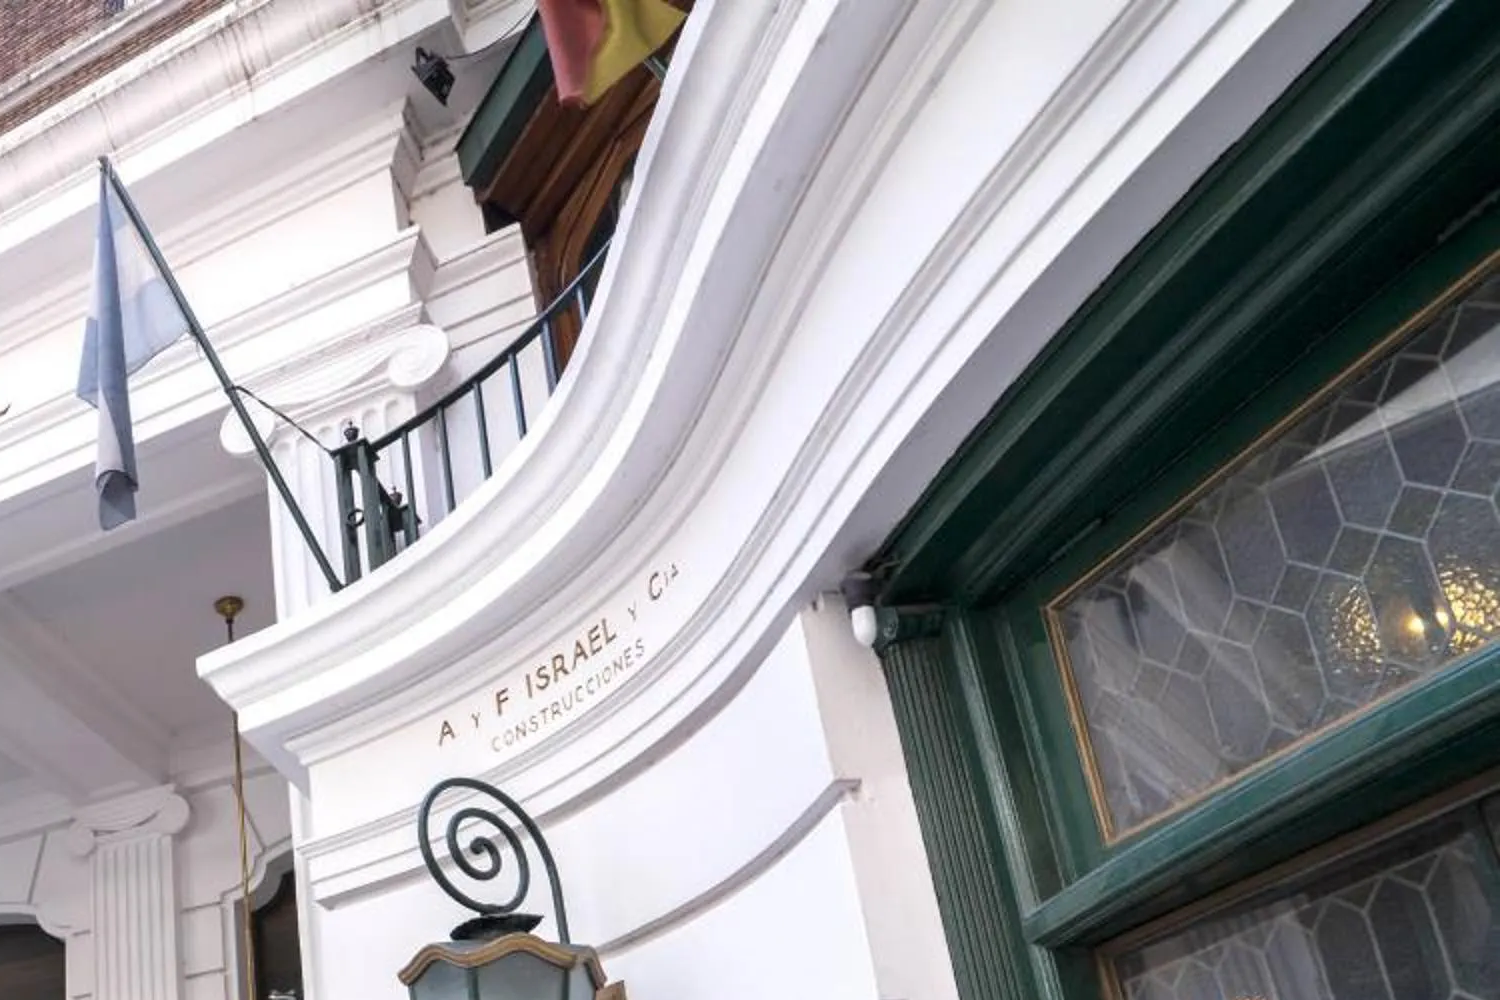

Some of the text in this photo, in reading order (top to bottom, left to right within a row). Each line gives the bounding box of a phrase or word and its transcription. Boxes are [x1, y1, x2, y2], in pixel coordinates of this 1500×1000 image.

[438, 720, 456, 746] A
[470, 711, 482, 728] Y
[495, 687, 510, 716] F
[524, 618, 618, 699] ISRAEL
[491, 638, 646, 752] CONSTRUCCIONES
